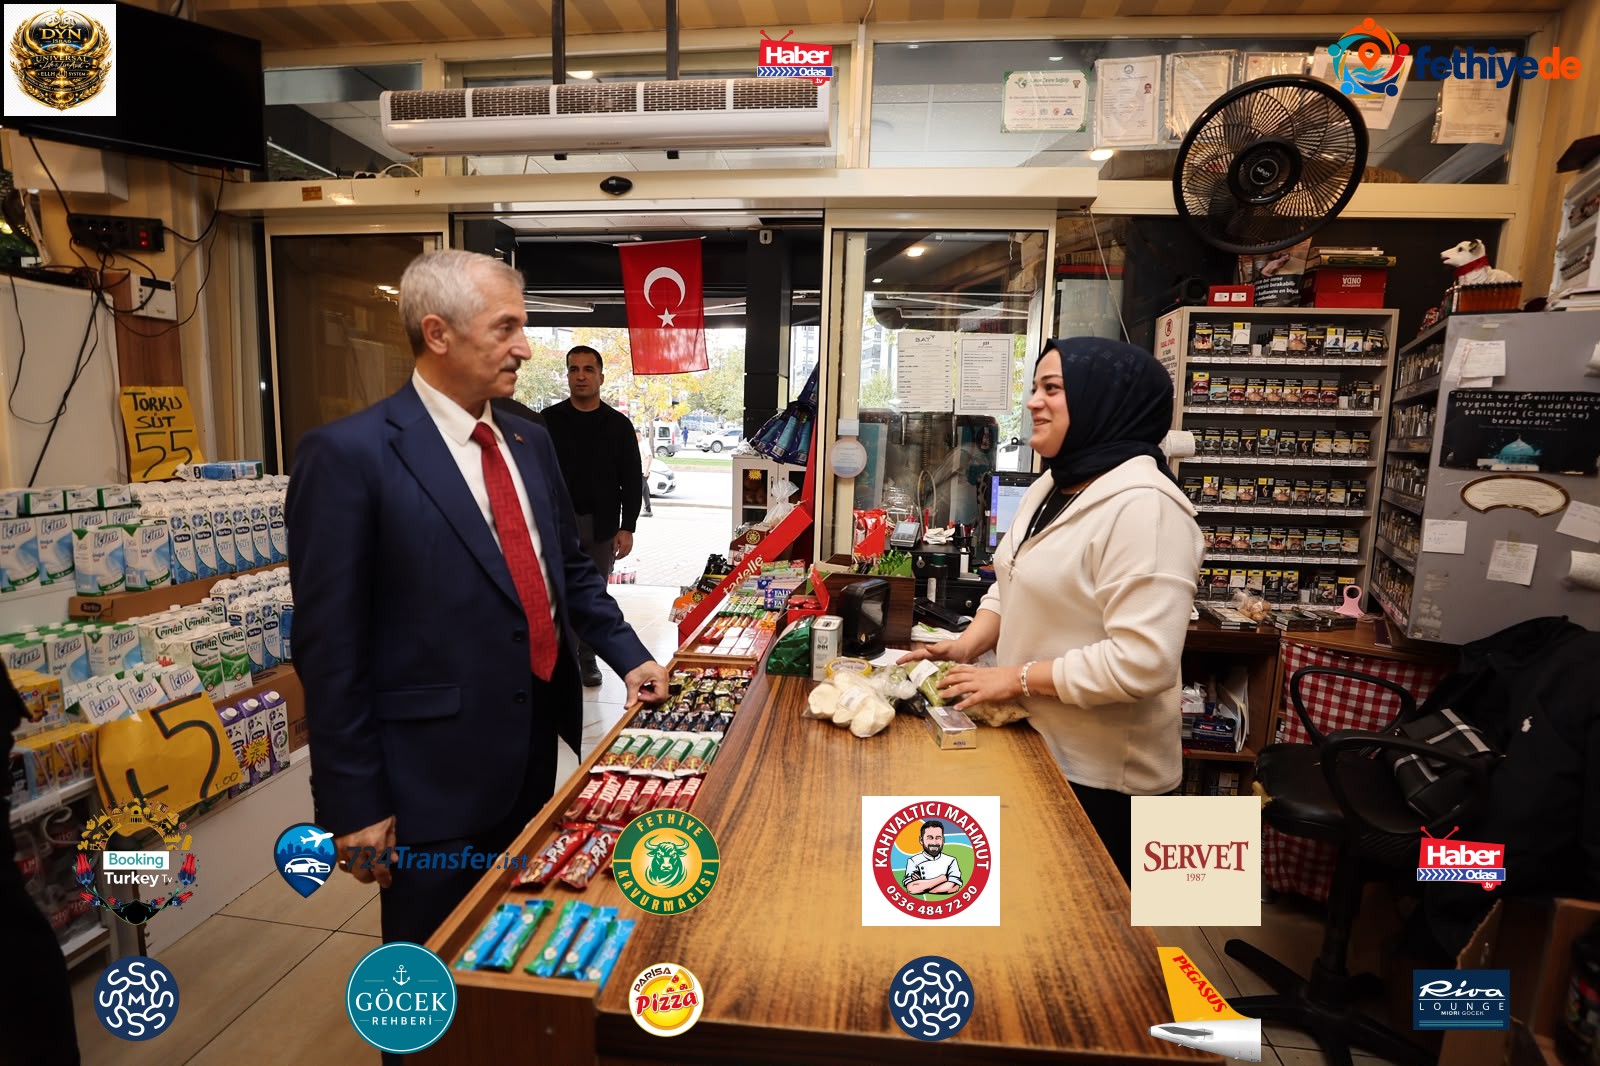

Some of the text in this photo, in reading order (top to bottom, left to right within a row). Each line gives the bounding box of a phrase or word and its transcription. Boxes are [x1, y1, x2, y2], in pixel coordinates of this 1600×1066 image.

[124, 391, 182, 411] TORKU
[134, 412, 176, 429] SÜT
[134, 429, 194, 479] 55
